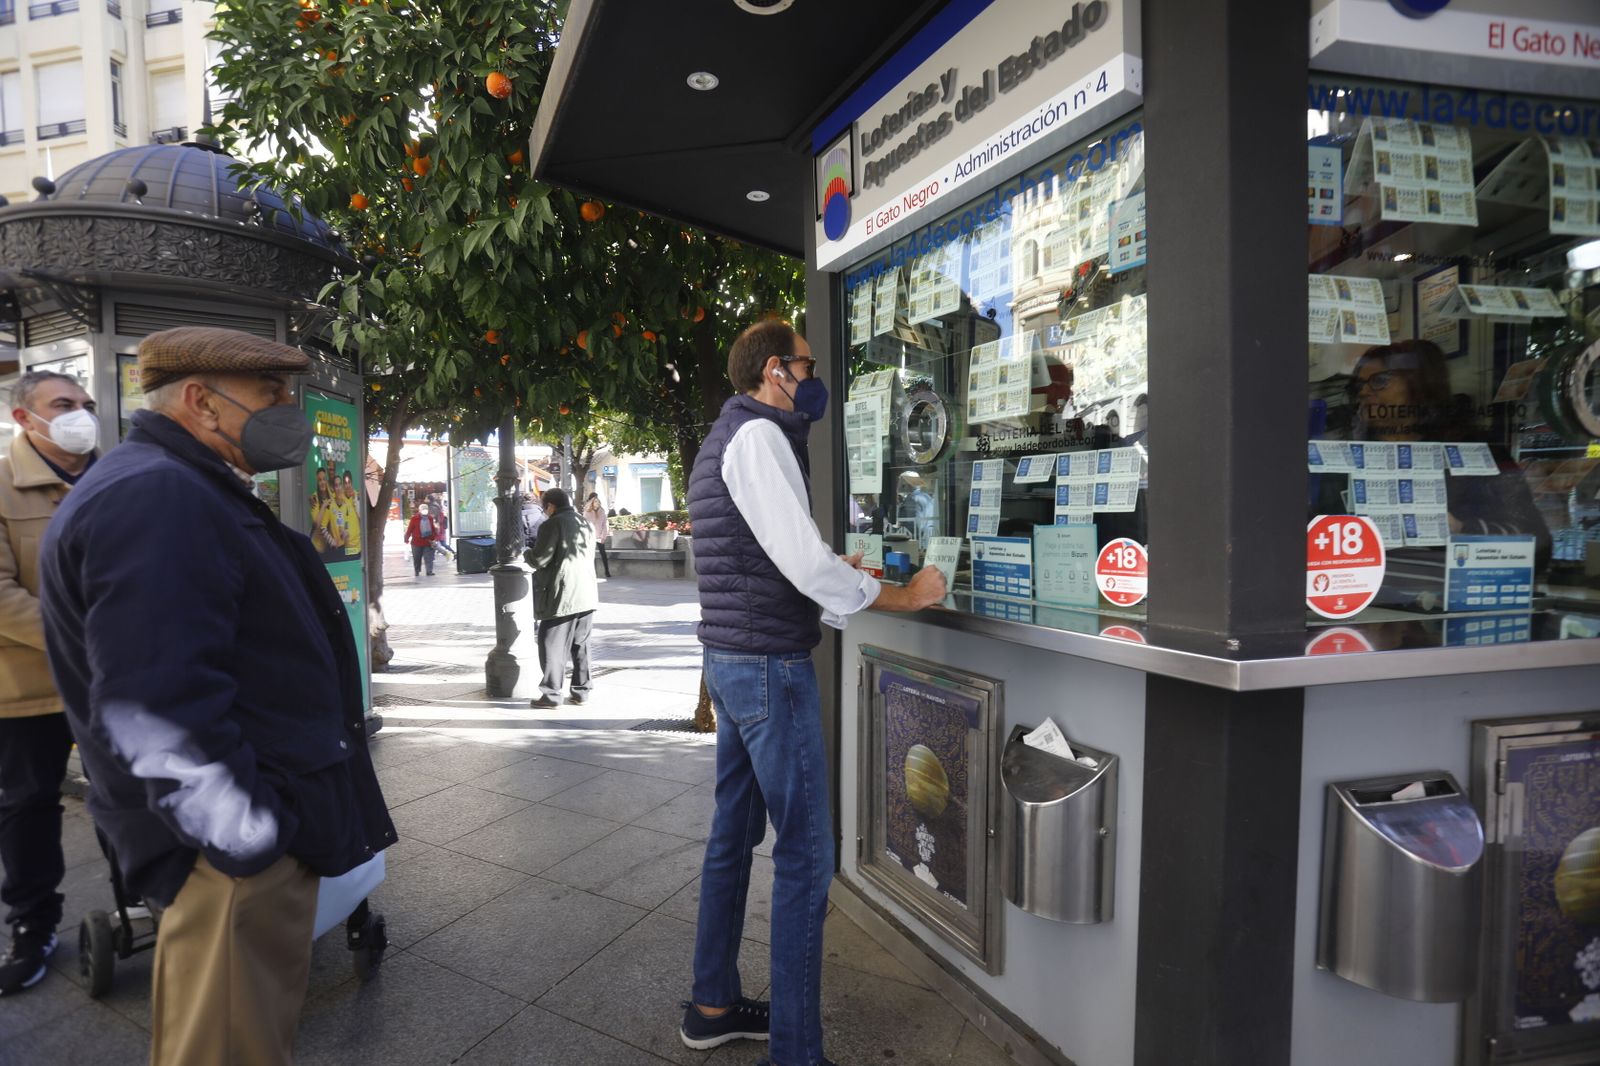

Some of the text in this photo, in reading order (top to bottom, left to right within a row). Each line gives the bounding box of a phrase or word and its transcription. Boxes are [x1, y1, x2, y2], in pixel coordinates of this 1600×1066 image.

[1488, 22, 1505, 49] El
[1512, 25, 1566, 56] Gato
[861, 67, 958, 157] Loterías y
[863, 0, 1109, 190] Apuestas del Estado
[1308, 82, 1600, 137] www.la4decor
[866, 217, 874, 235] El
[876, 205, 900, 229] Gato
[903, 181, 939, 213] Negro
[953, 102, 1068, 183] Administración
[1095, 70, 1109, 94] 4
[316, 410, 348, 426] CUANDO
[1106, 547, 1137, 569] +18
[1314, 521, 1364, 556] +18
